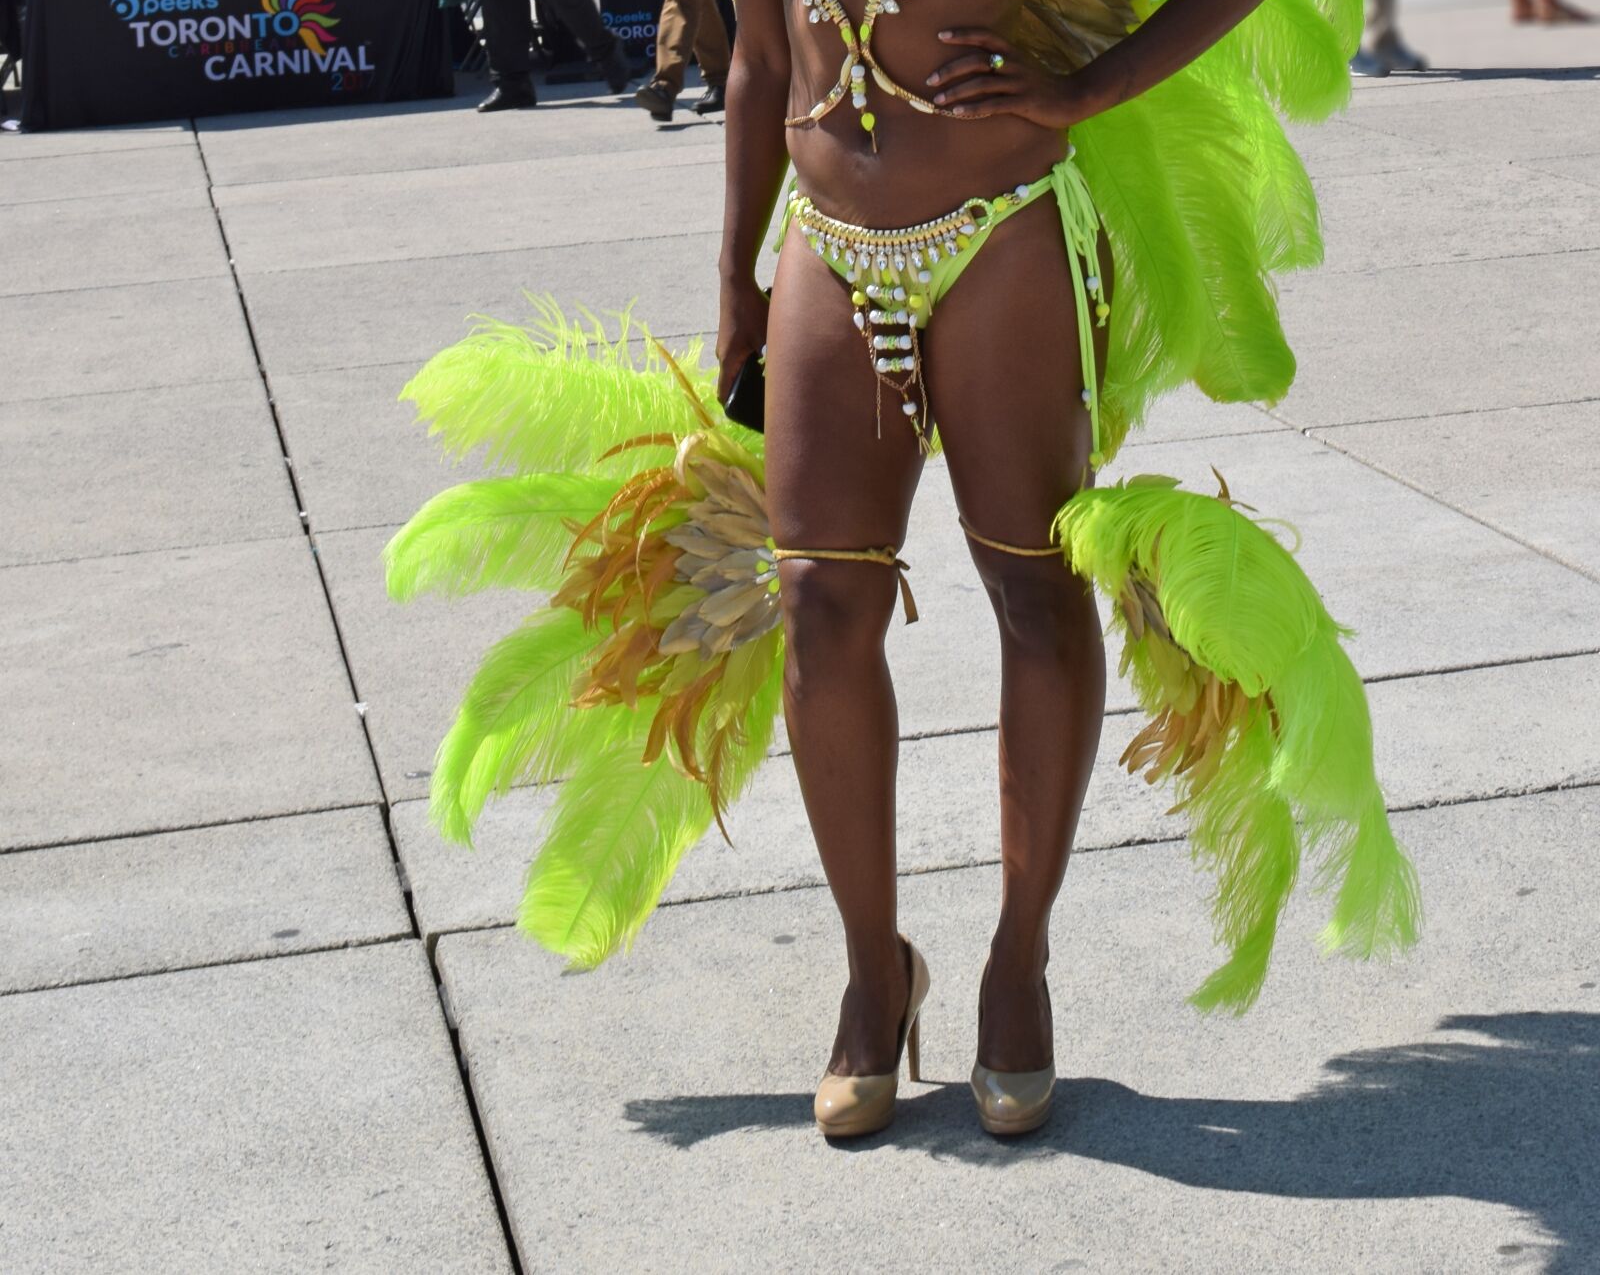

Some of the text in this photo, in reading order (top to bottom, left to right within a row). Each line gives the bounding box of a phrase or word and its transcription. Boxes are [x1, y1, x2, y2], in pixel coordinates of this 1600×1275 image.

[129, 10, 300, 48] TORONTO
[168, 37, 298, 59] CARIBBEAN
[204, 45, 375, 81] CARNIVAL
